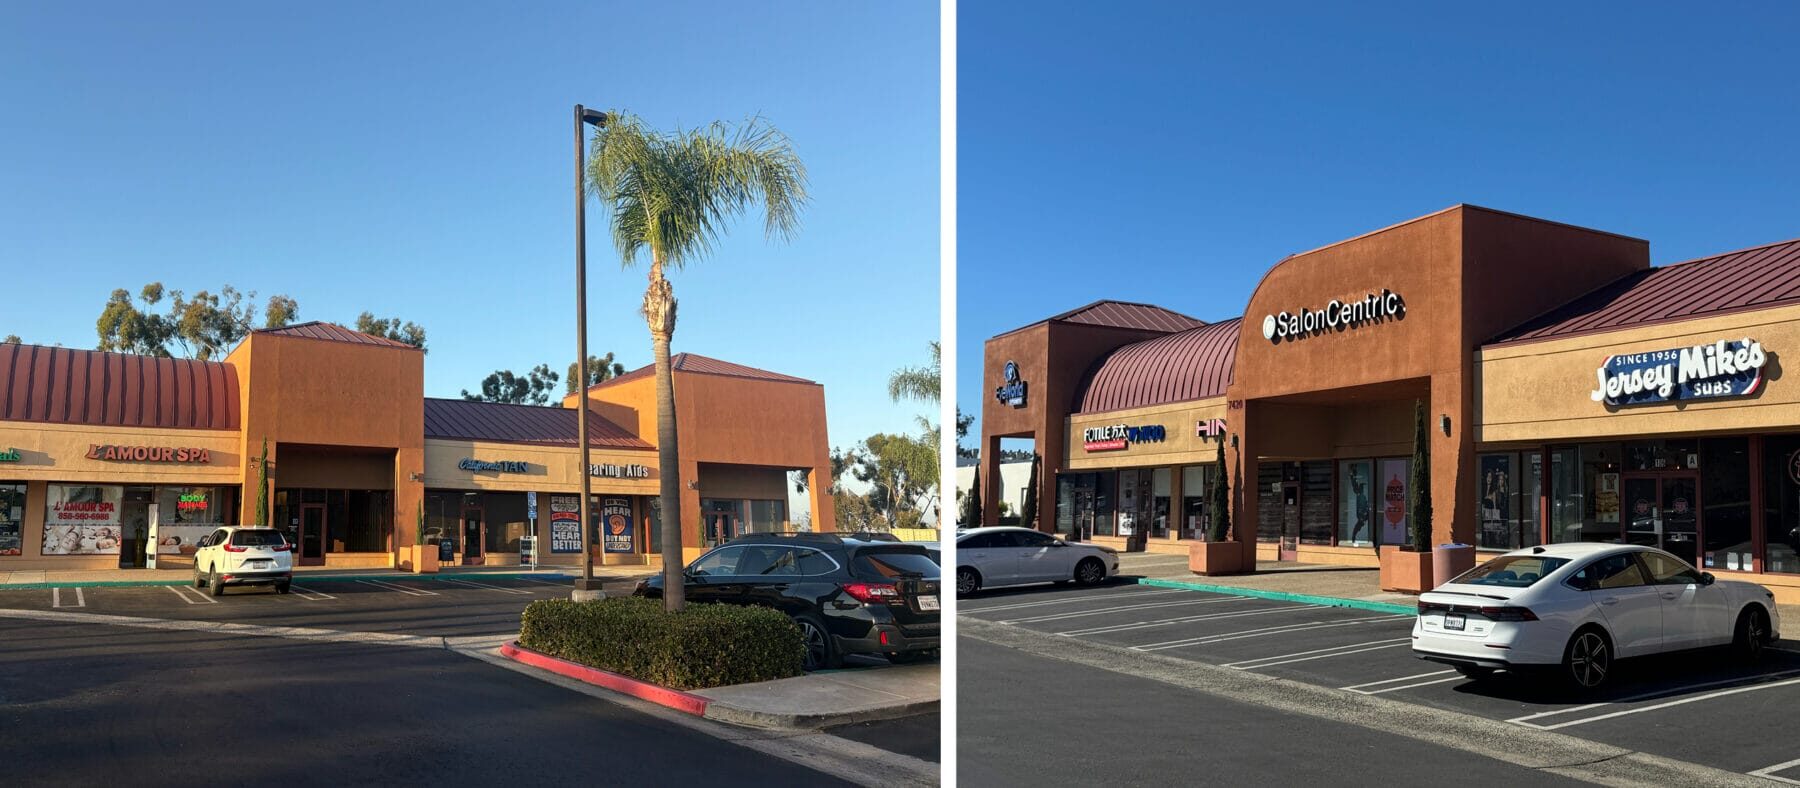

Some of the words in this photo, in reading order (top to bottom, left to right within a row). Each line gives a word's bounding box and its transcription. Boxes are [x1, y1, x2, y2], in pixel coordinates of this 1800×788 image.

[1616, 354, 1648, 366] SINCE
[1652, 350, 1677, 362] 1956
[1591, 363, 1674, 401] Jersey
[1678, 337, 1767, 384] Mike's
[1694, 380, 1732, 396] SUBS
[1228, 400, 1243, 410] 7420
[1084, 426, 1110, 442] FOTILE
[104, 445, 173, 461] AMOUR
[177, 447, 210, 463] SPA
[459, 457, 500, 473] California
[500, 461, 528, 472] TAN
[626, 464, 649, 478] Aids
[99, 503, 114, 512] SPA
[604, 507, 631, 516] HEAR
[552, 531, 580, 540] HEAR
[553, 540, 582, 550] BETTER
